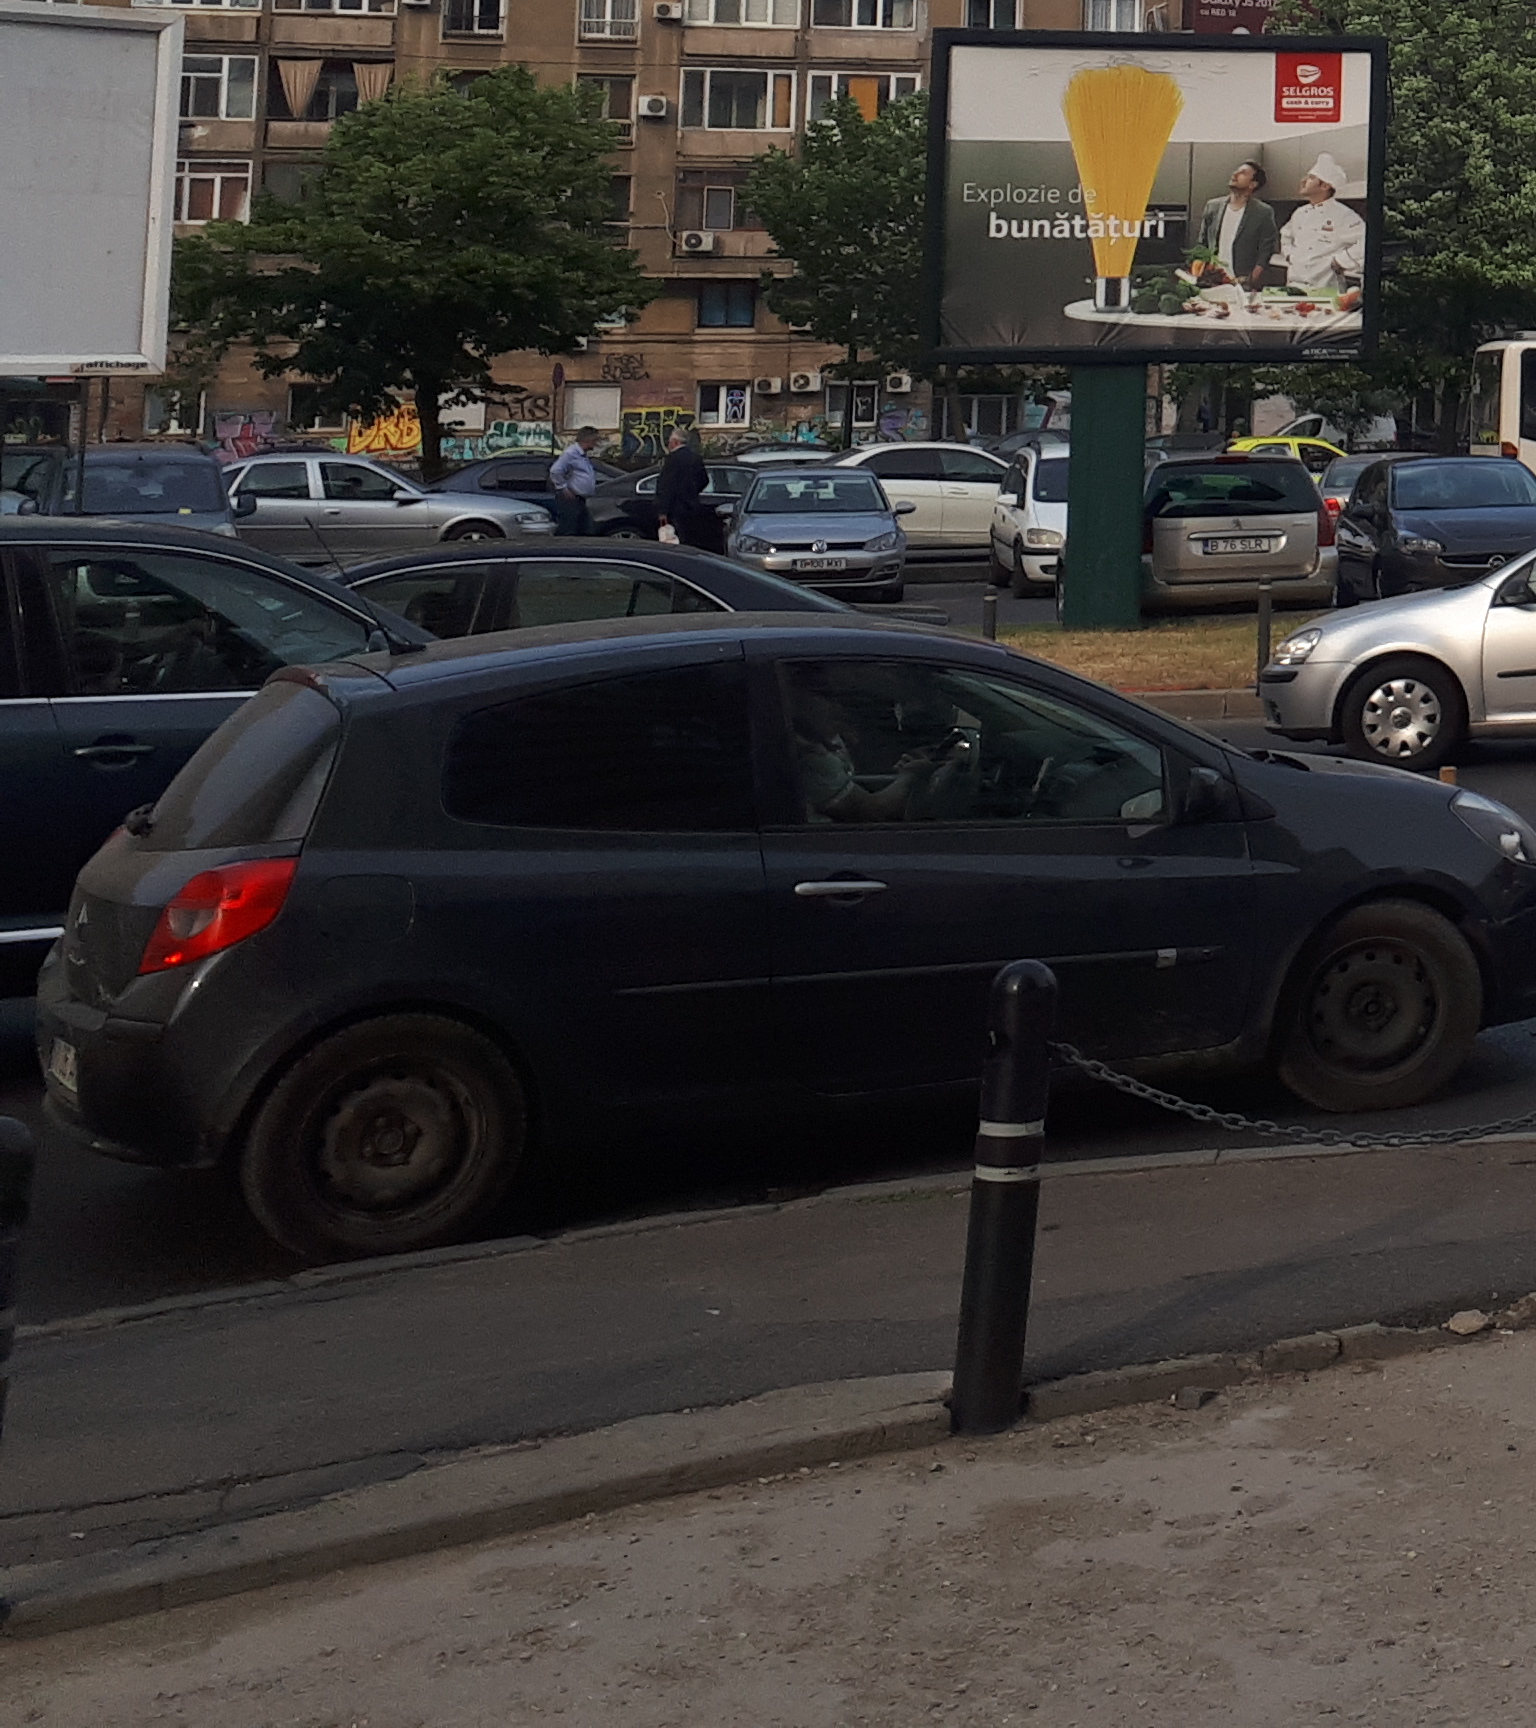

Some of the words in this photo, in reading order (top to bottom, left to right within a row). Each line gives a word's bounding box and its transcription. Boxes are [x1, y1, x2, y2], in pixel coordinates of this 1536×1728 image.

[1282, 86, 1334, 96] SELGROS
[963, 182, 1061, 208] Explozie
[1067, 181, 1097, 203] de
[1211, 540, 1218, 551] B
[1223, 539, 1237, 550] 76
[1240, 538, 1263, 550] SLR
